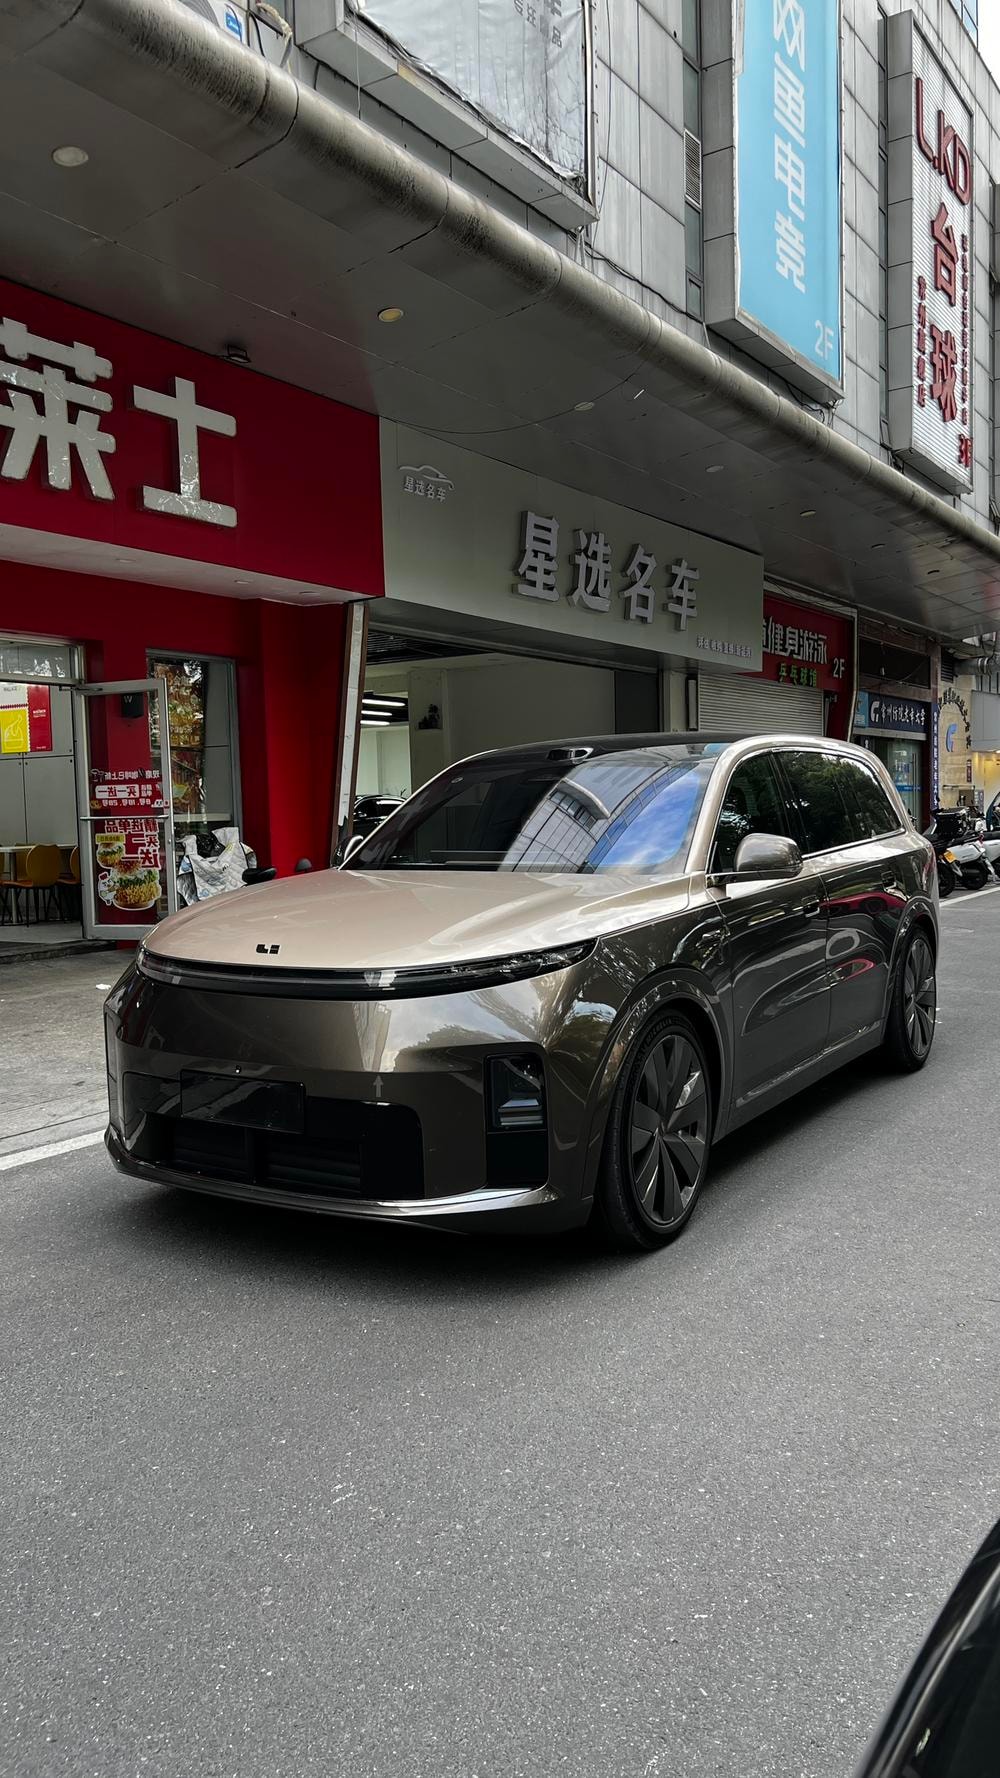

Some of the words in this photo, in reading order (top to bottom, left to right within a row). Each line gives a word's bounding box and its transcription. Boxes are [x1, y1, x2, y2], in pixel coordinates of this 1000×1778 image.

[930, 201, 960, 422] 台球
[814, 319, 834, 360] 2F
[403, 475, 446, 503] 星选名车
[512, 510, 700, 631] 星选名车
[778, 662, 817, 688] 乒乓球馆
[833, 657, 846, 679] 2F
